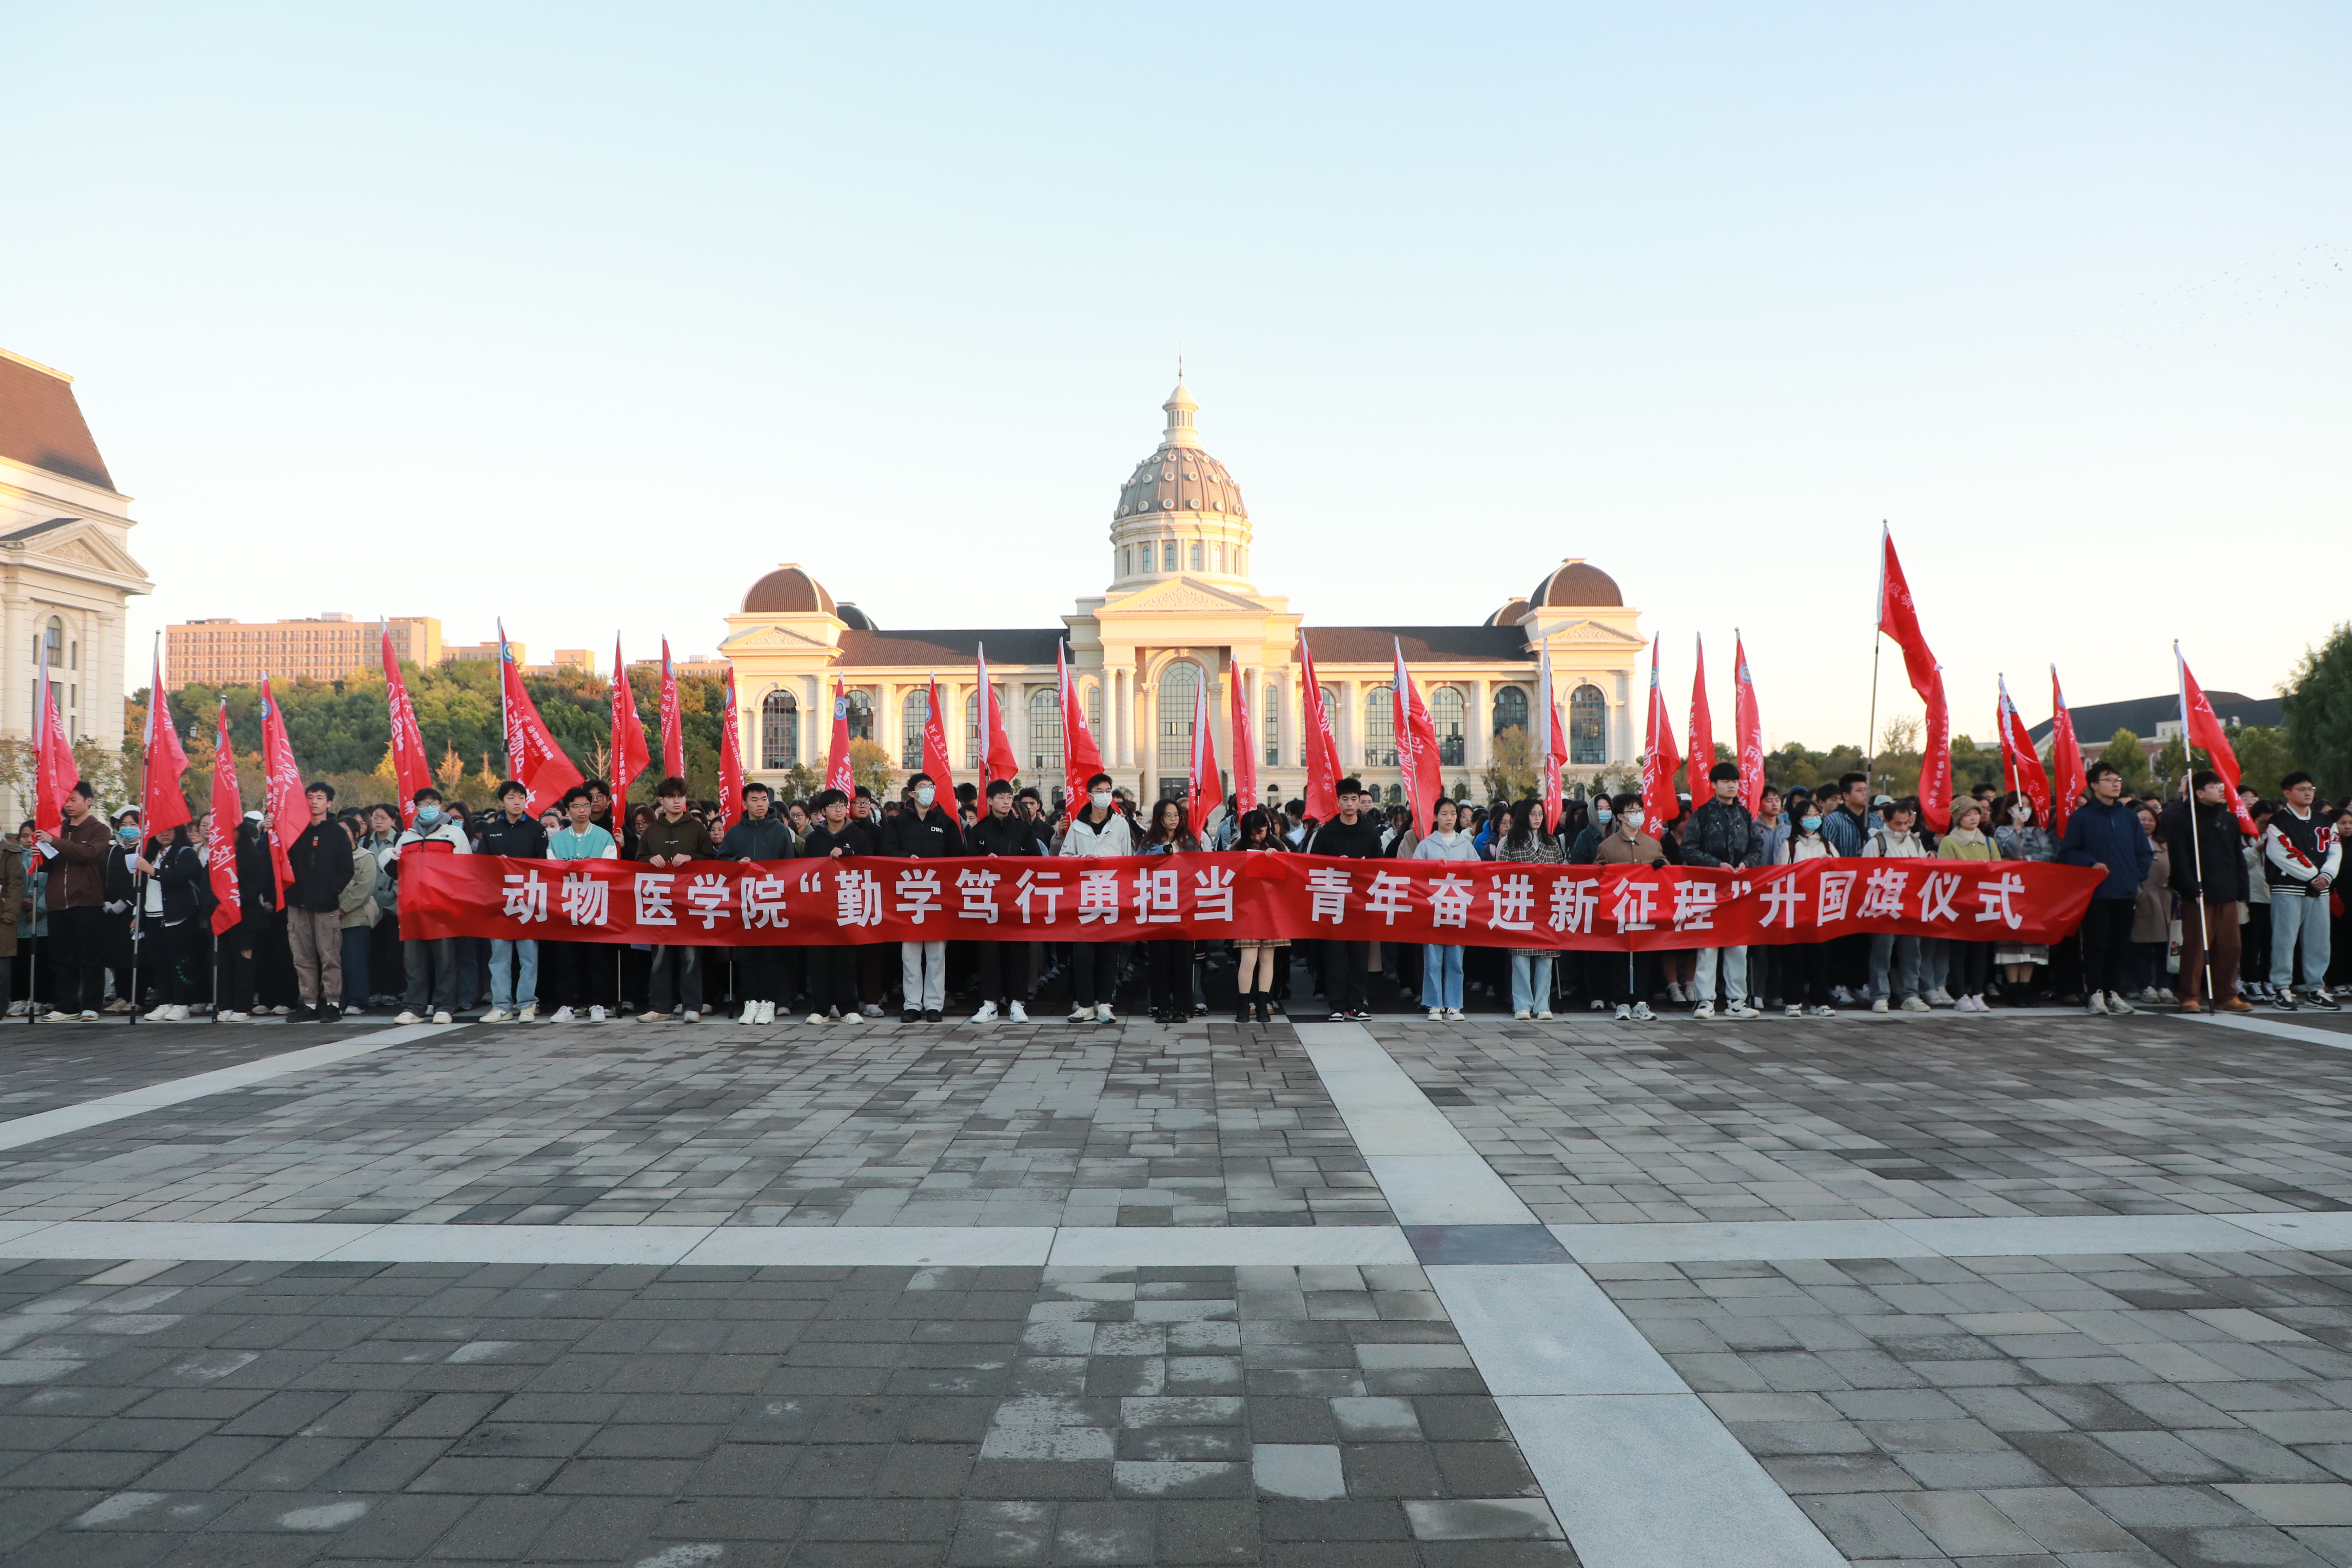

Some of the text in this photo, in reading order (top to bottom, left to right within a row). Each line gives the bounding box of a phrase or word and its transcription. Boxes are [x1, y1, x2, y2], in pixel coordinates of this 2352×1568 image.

[527, 724, 554, 761] 动物医学院
[1306, 867, 2025, 934] 青年奋进新征程”升国旗仪式
